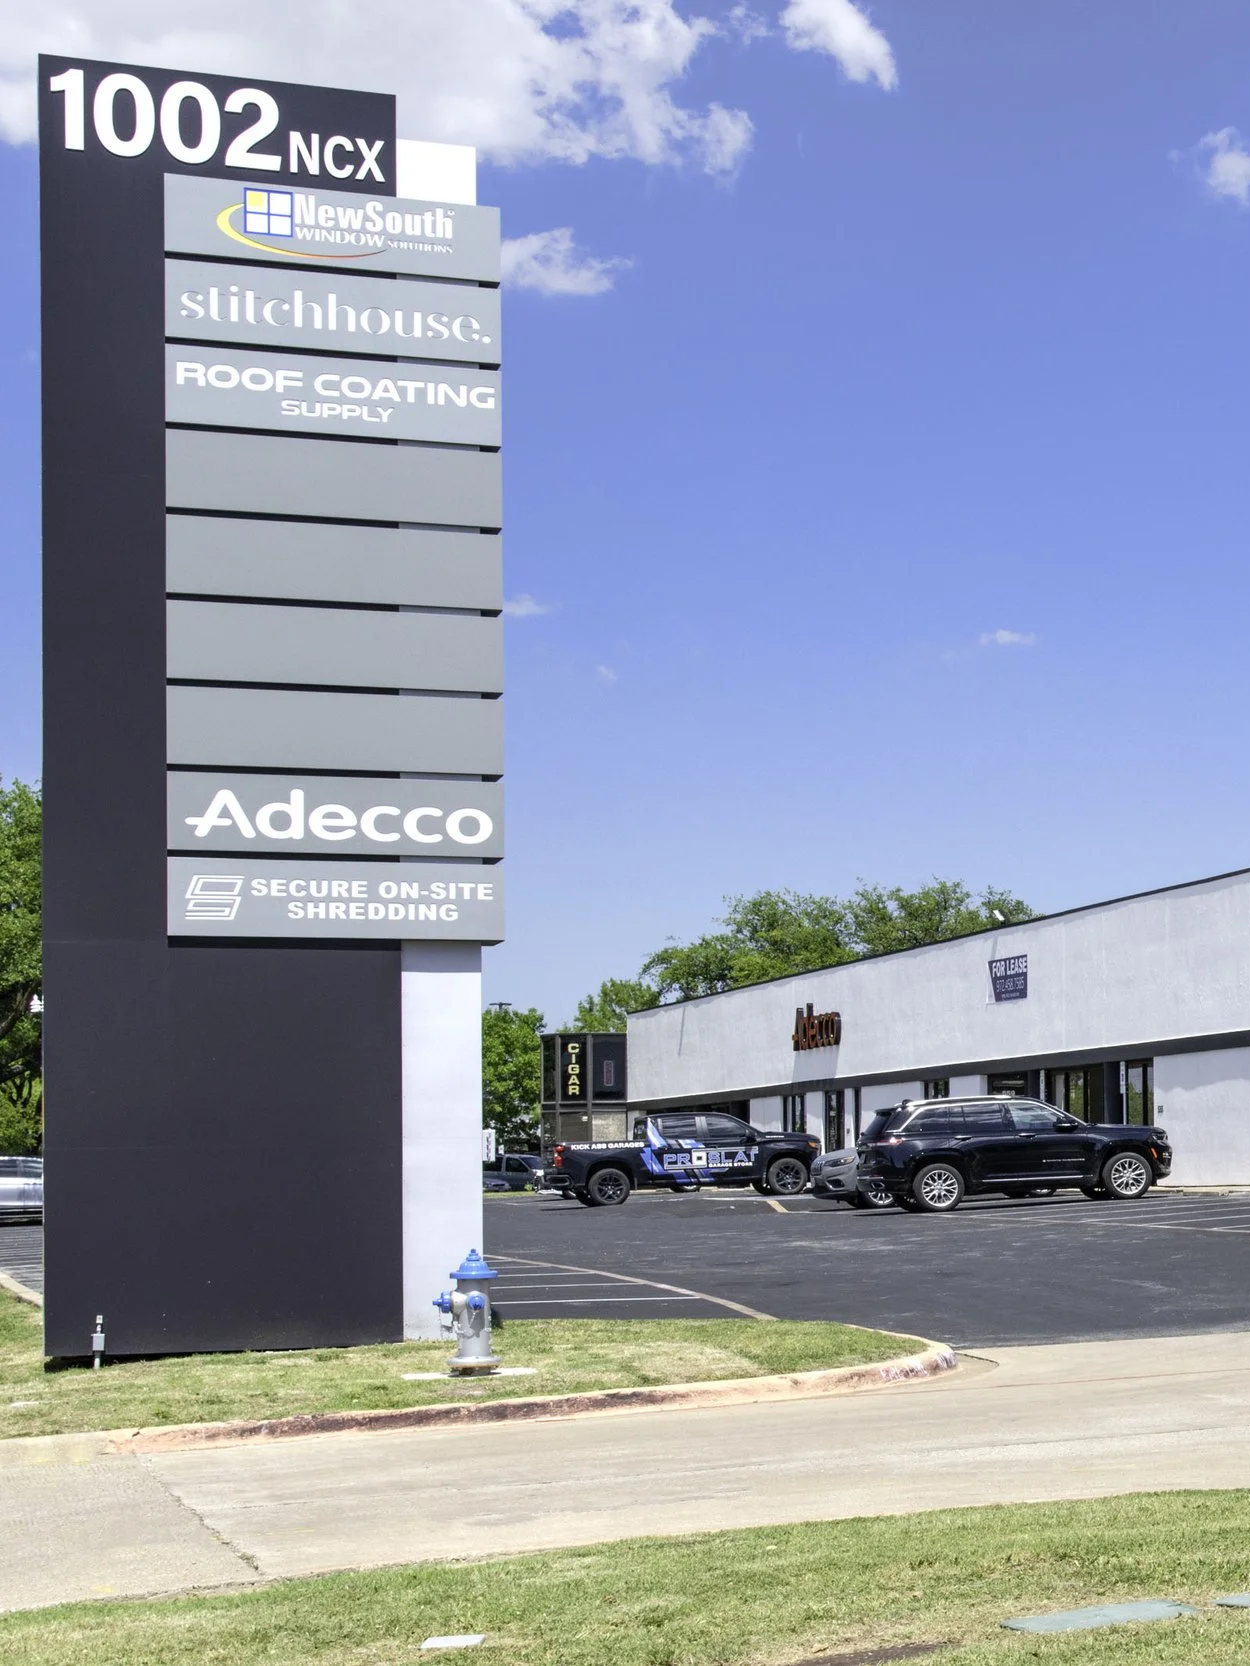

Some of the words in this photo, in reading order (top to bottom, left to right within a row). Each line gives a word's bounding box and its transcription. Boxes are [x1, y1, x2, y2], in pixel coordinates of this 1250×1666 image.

[49, 68, 282, 173] 1002
[289, 131, 386, 182] NCX
[295, 226, 385, 248] WINDOW
[387, 239, 453, 254] SOLUTIONS
[180, 285, 492, 344] stitchhouse.
[175, 361, 303, 393] ROOF
[314, 374, 496, 409] COATING
[281, 399, 395, 423] SUPPLY
[184, 788, 494, 845] Adecco
[250, 878, 368, 898] SECURE
[379, 881, 494, 901] ON-SITE
[287, 902, 459, 921] SHREDDING
[992, 960, 1005, 978] FOR
[1006, 956, 1027, 975] LEASE
[567, 1043, 580, 1096] CIGAR
[591, 1142, 607, 1150] ASS
[607, 1141, 645, 1149] GARAGES
[663, 1147, 759, 1168] PROSLAT
